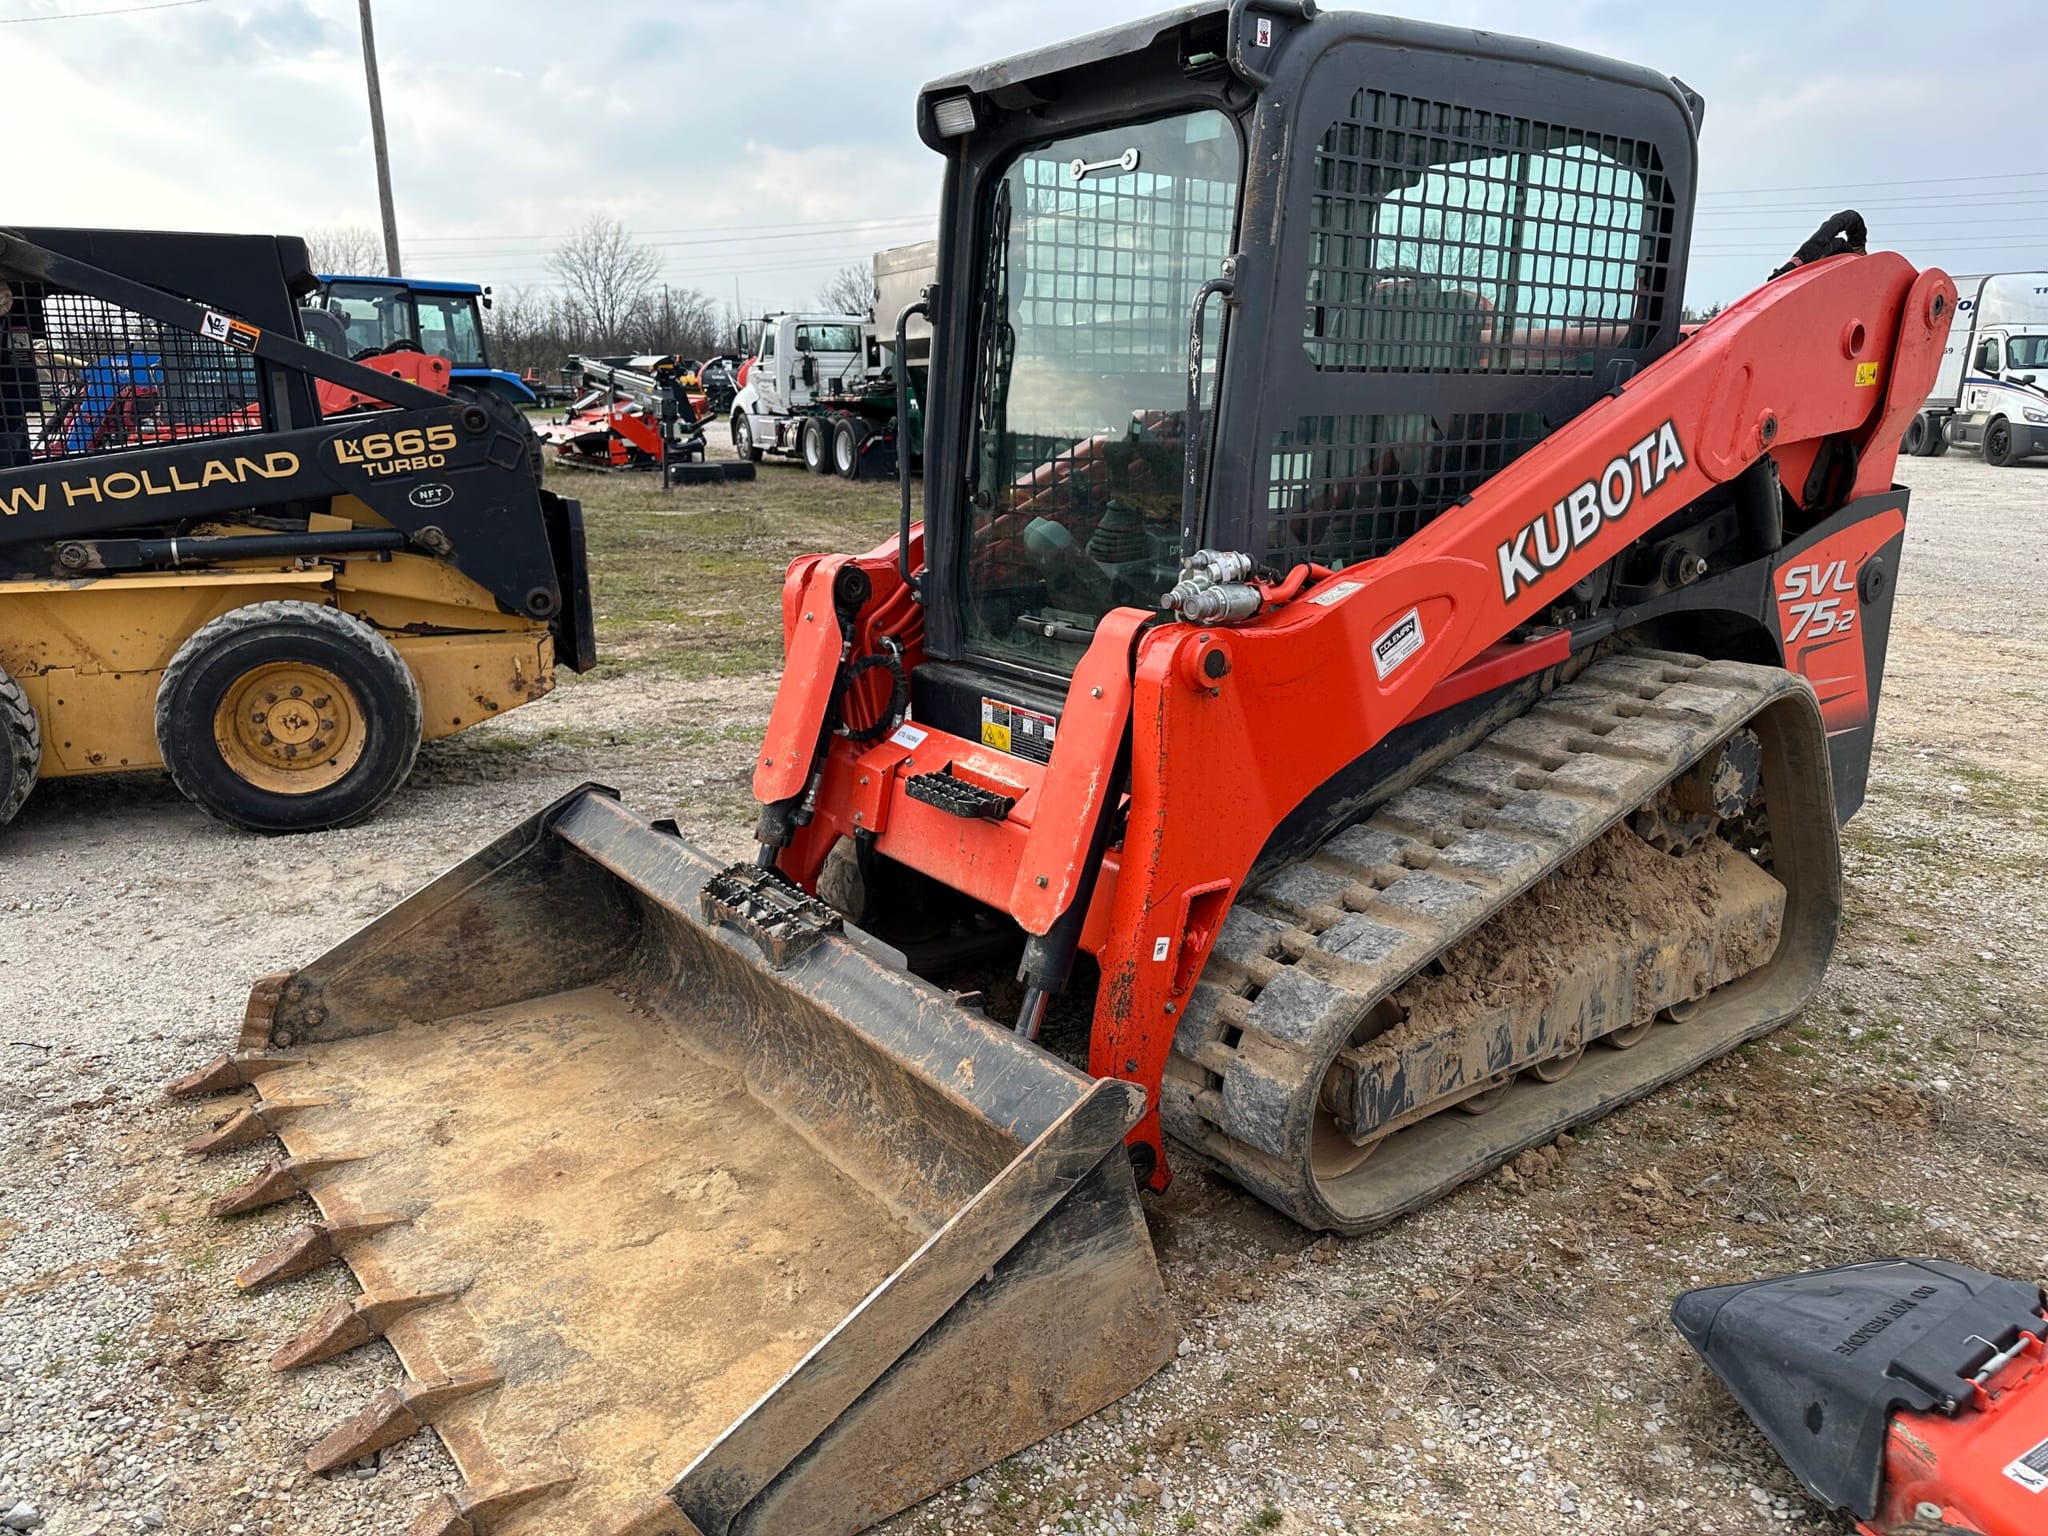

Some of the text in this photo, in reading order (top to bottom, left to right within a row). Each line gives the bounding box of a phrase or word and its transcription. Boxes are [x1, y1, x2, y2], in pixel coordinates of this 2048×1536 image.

[61, 451, 300, 507] HOLLAND
[361, 453, 446, 477] TURBO
[419, 488, 443, 500] NFT
[1497, 420, 1686, 602] KUBOTA
[1779, 560, 1855, 602] SVL
[1379, 621, 1414, 654] COLEMAN
[1784, 598, 1856, 644] 75-2
[1832, 1285, 1939, 1356] DO NOT REMOVE
